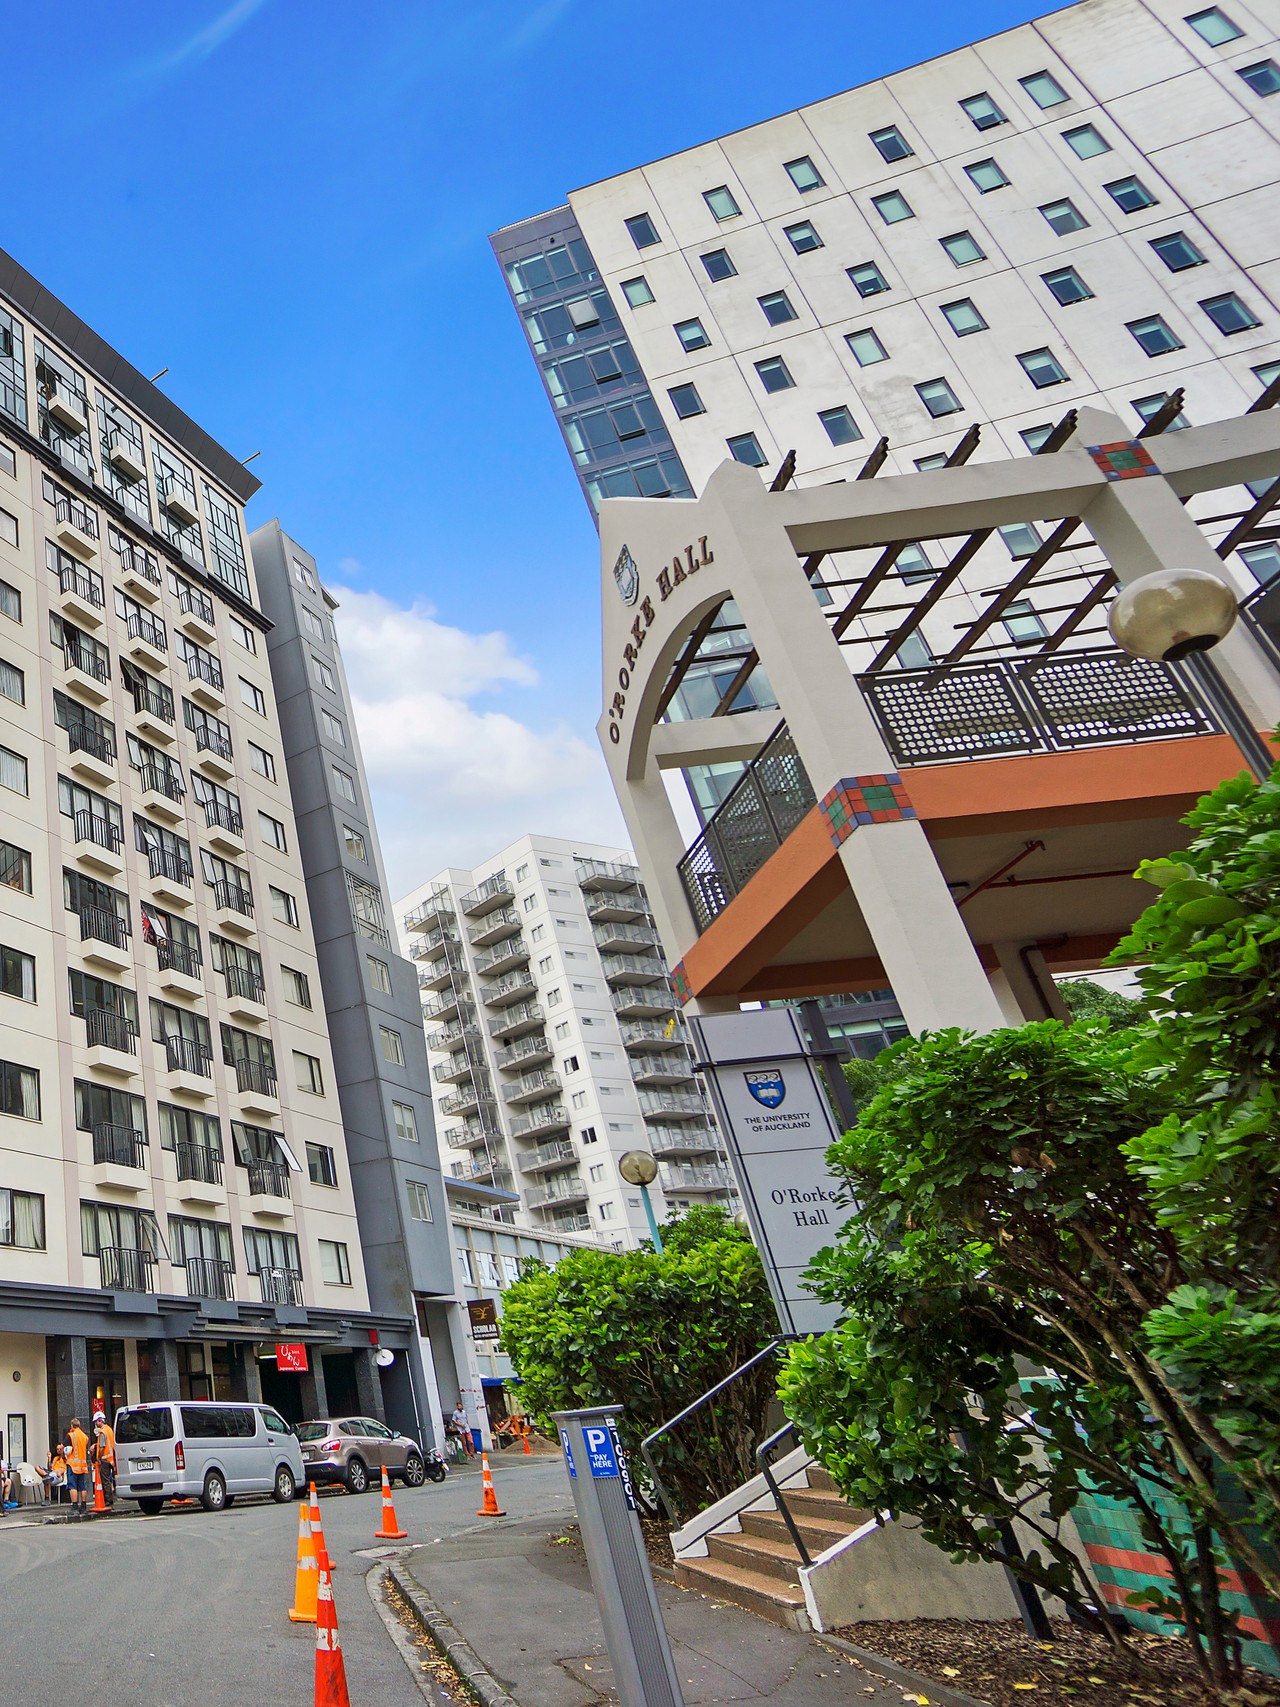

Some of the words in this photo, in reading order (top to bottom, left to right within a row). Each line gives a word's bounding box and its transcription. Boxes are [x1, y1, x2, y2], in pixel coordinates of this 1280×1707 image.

[609, 595, 656, 744] O'RORKE
[656, 535, 714, 602] HALL
[744, 1116, 761, 1125] THE
[763, 1112, 810, 1123] UNIVERSITY
[752, 1125, 764, 1133] OF
[765, 1121, 811, 1132] AUCKLAND
[771, 1186, 838, 1205] O'Rorke
[792, 1209, 830, 1227] Hall
[472, 1324, 497, 1335] SCHOLAR
[586, 1429, 606, 1453] P
[592, 1460, 613, 1469] HERE
[594, 1453, 608, 1461] PAY
[612, 1431, 636, 1509] 100901
